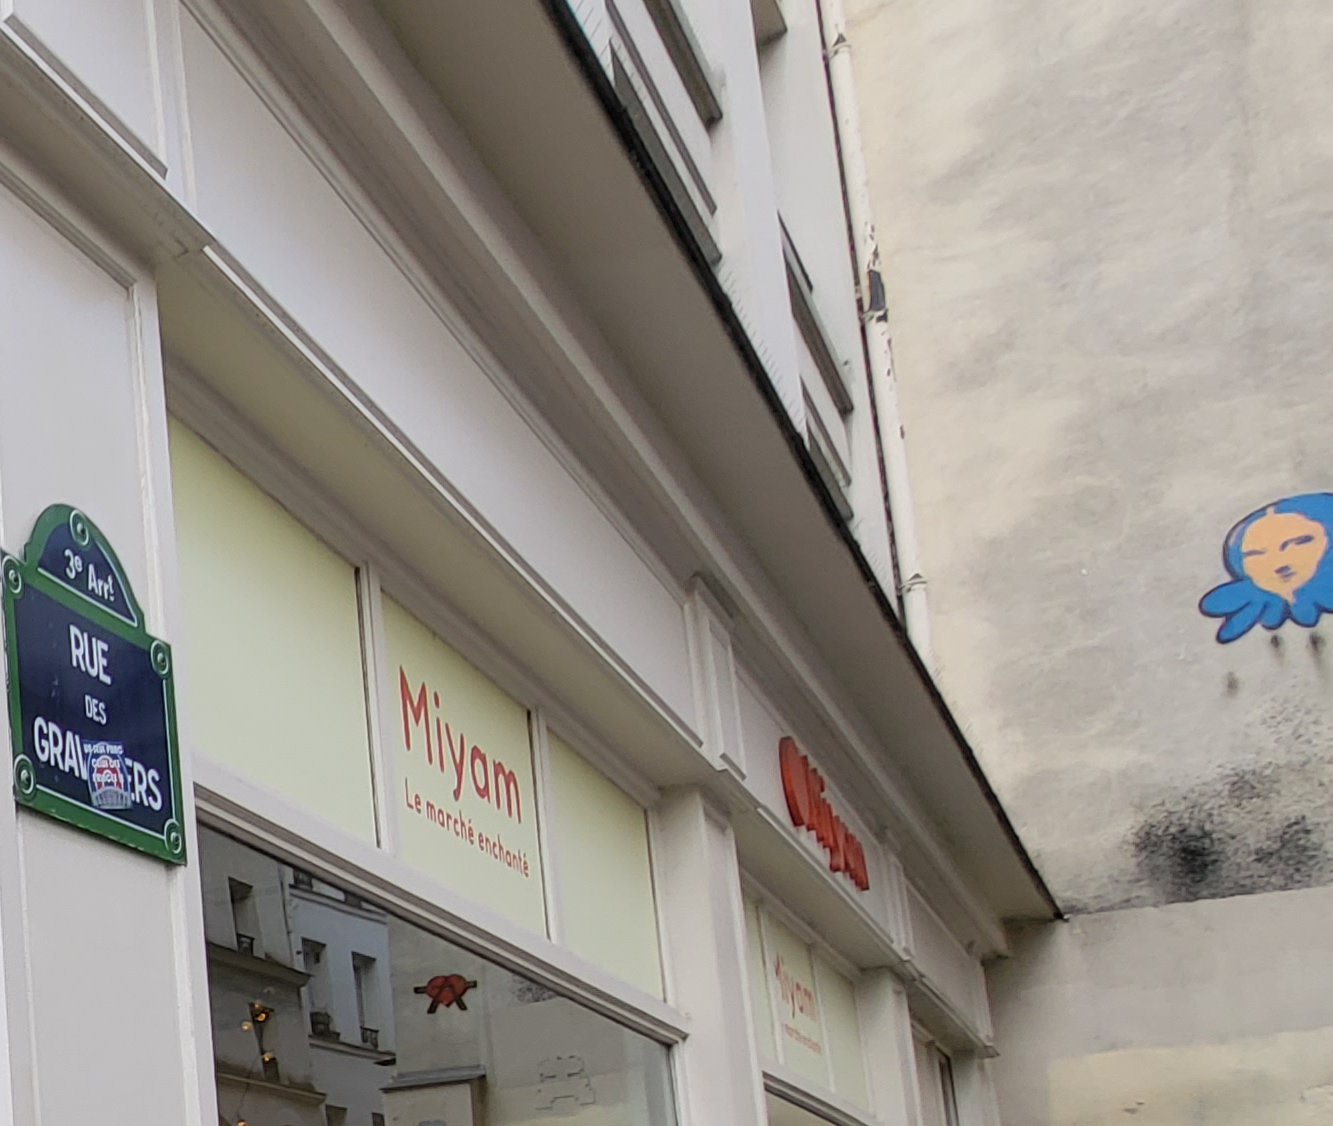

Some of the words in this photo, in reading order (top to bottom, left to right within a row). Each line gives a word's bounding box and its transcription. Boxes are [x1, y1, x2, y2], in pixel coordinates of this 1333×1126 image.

[69, 623, 112, 686] RUE
[84, 694, 107, 726] DES
[399, 664, 522, 825] Miyam
[404, 776, 422, 815] Le
[426, 800, 475, 846] marché
[478, 832, 530, 878] enchanté
